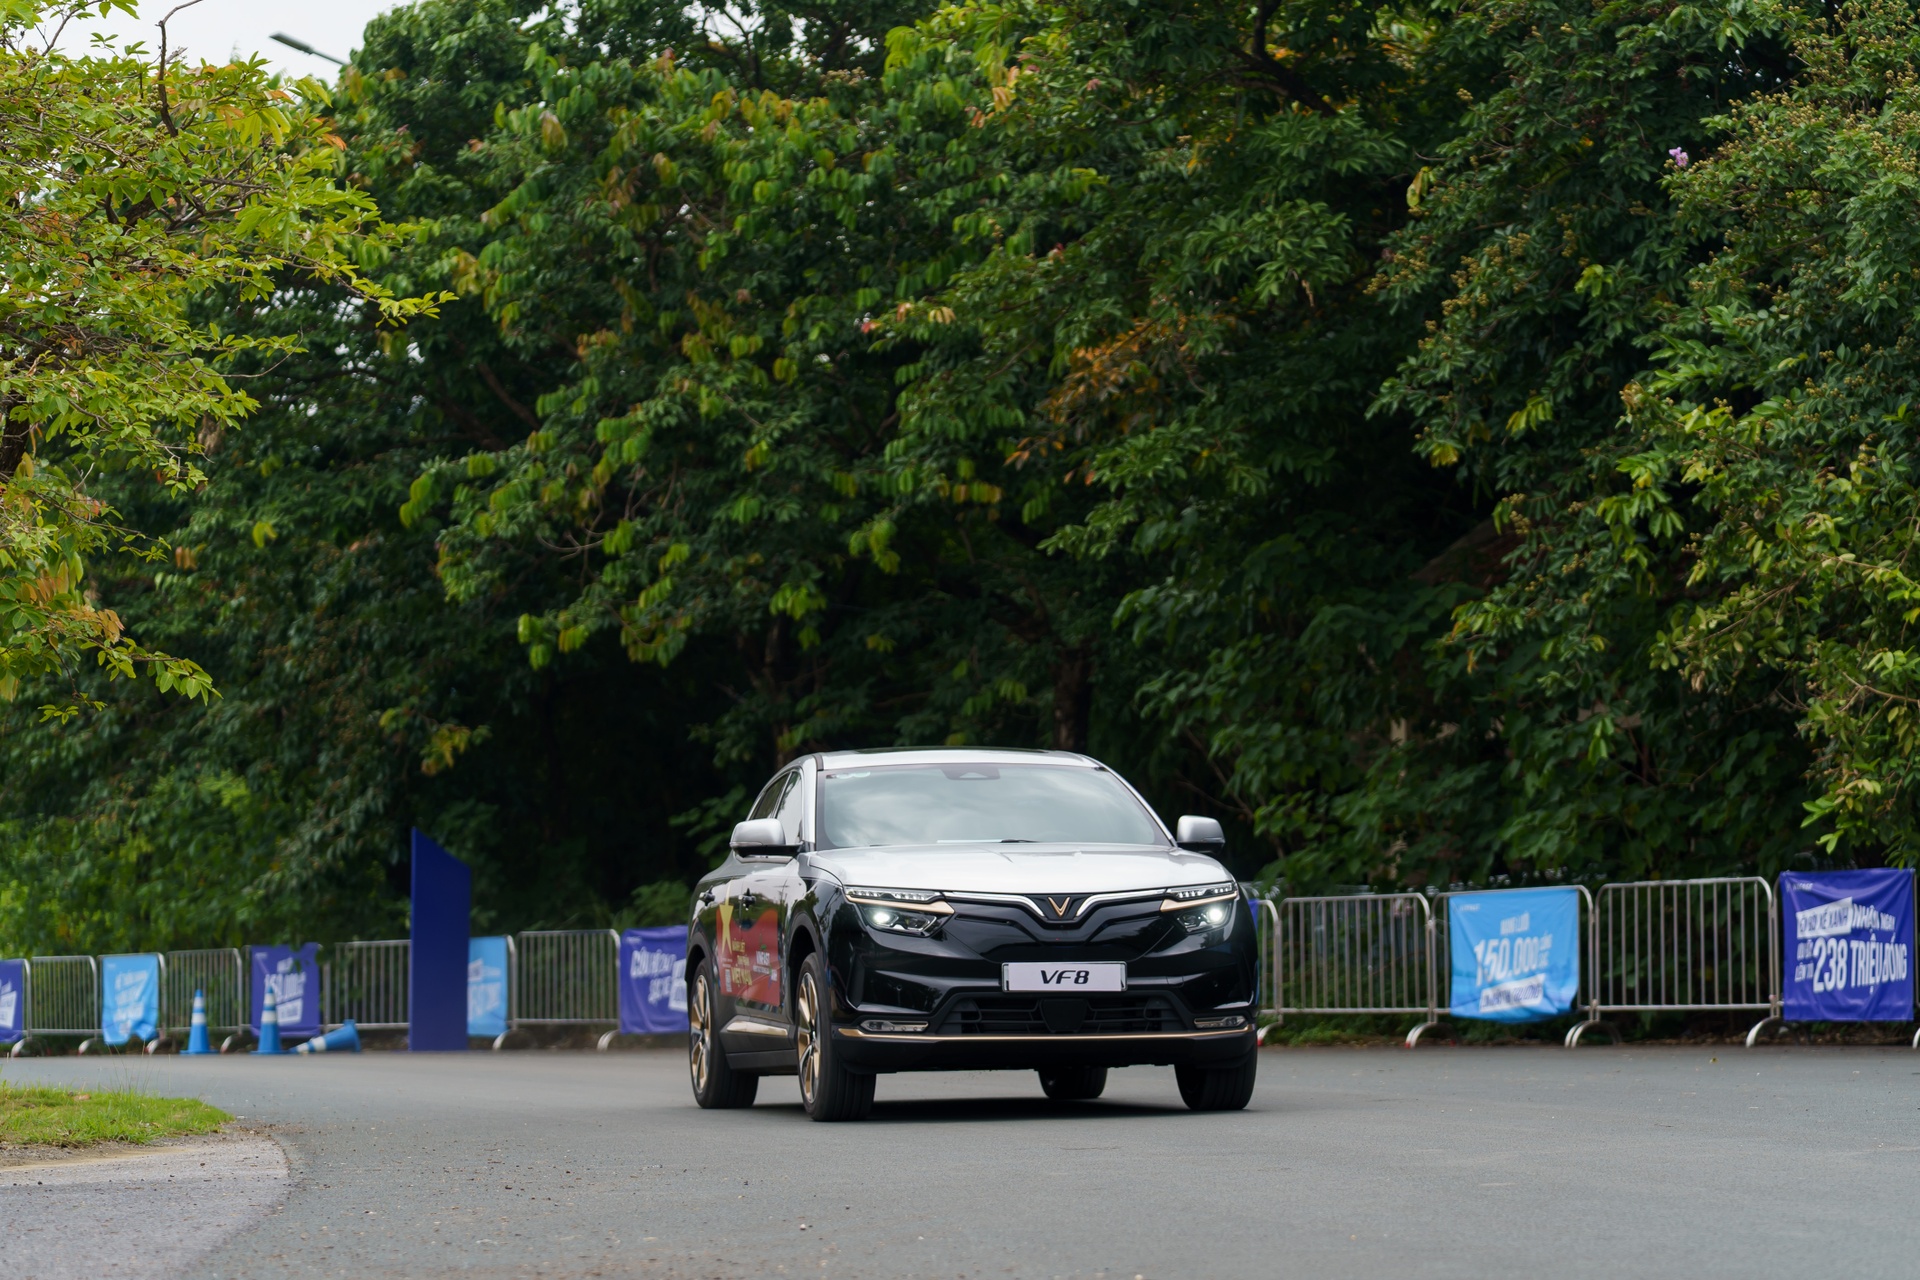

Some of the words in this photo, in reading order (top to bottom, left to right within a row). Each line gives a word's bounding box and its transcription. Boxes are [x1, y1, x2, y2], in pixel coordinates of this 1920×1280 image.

[1852, 903, 1880, 933] NHẬN
[1474, 937, 1539, 986] 150.000
[1814, 937, 1848, 993] 238
[1850, 932, 1883, 994] TRIỆU
